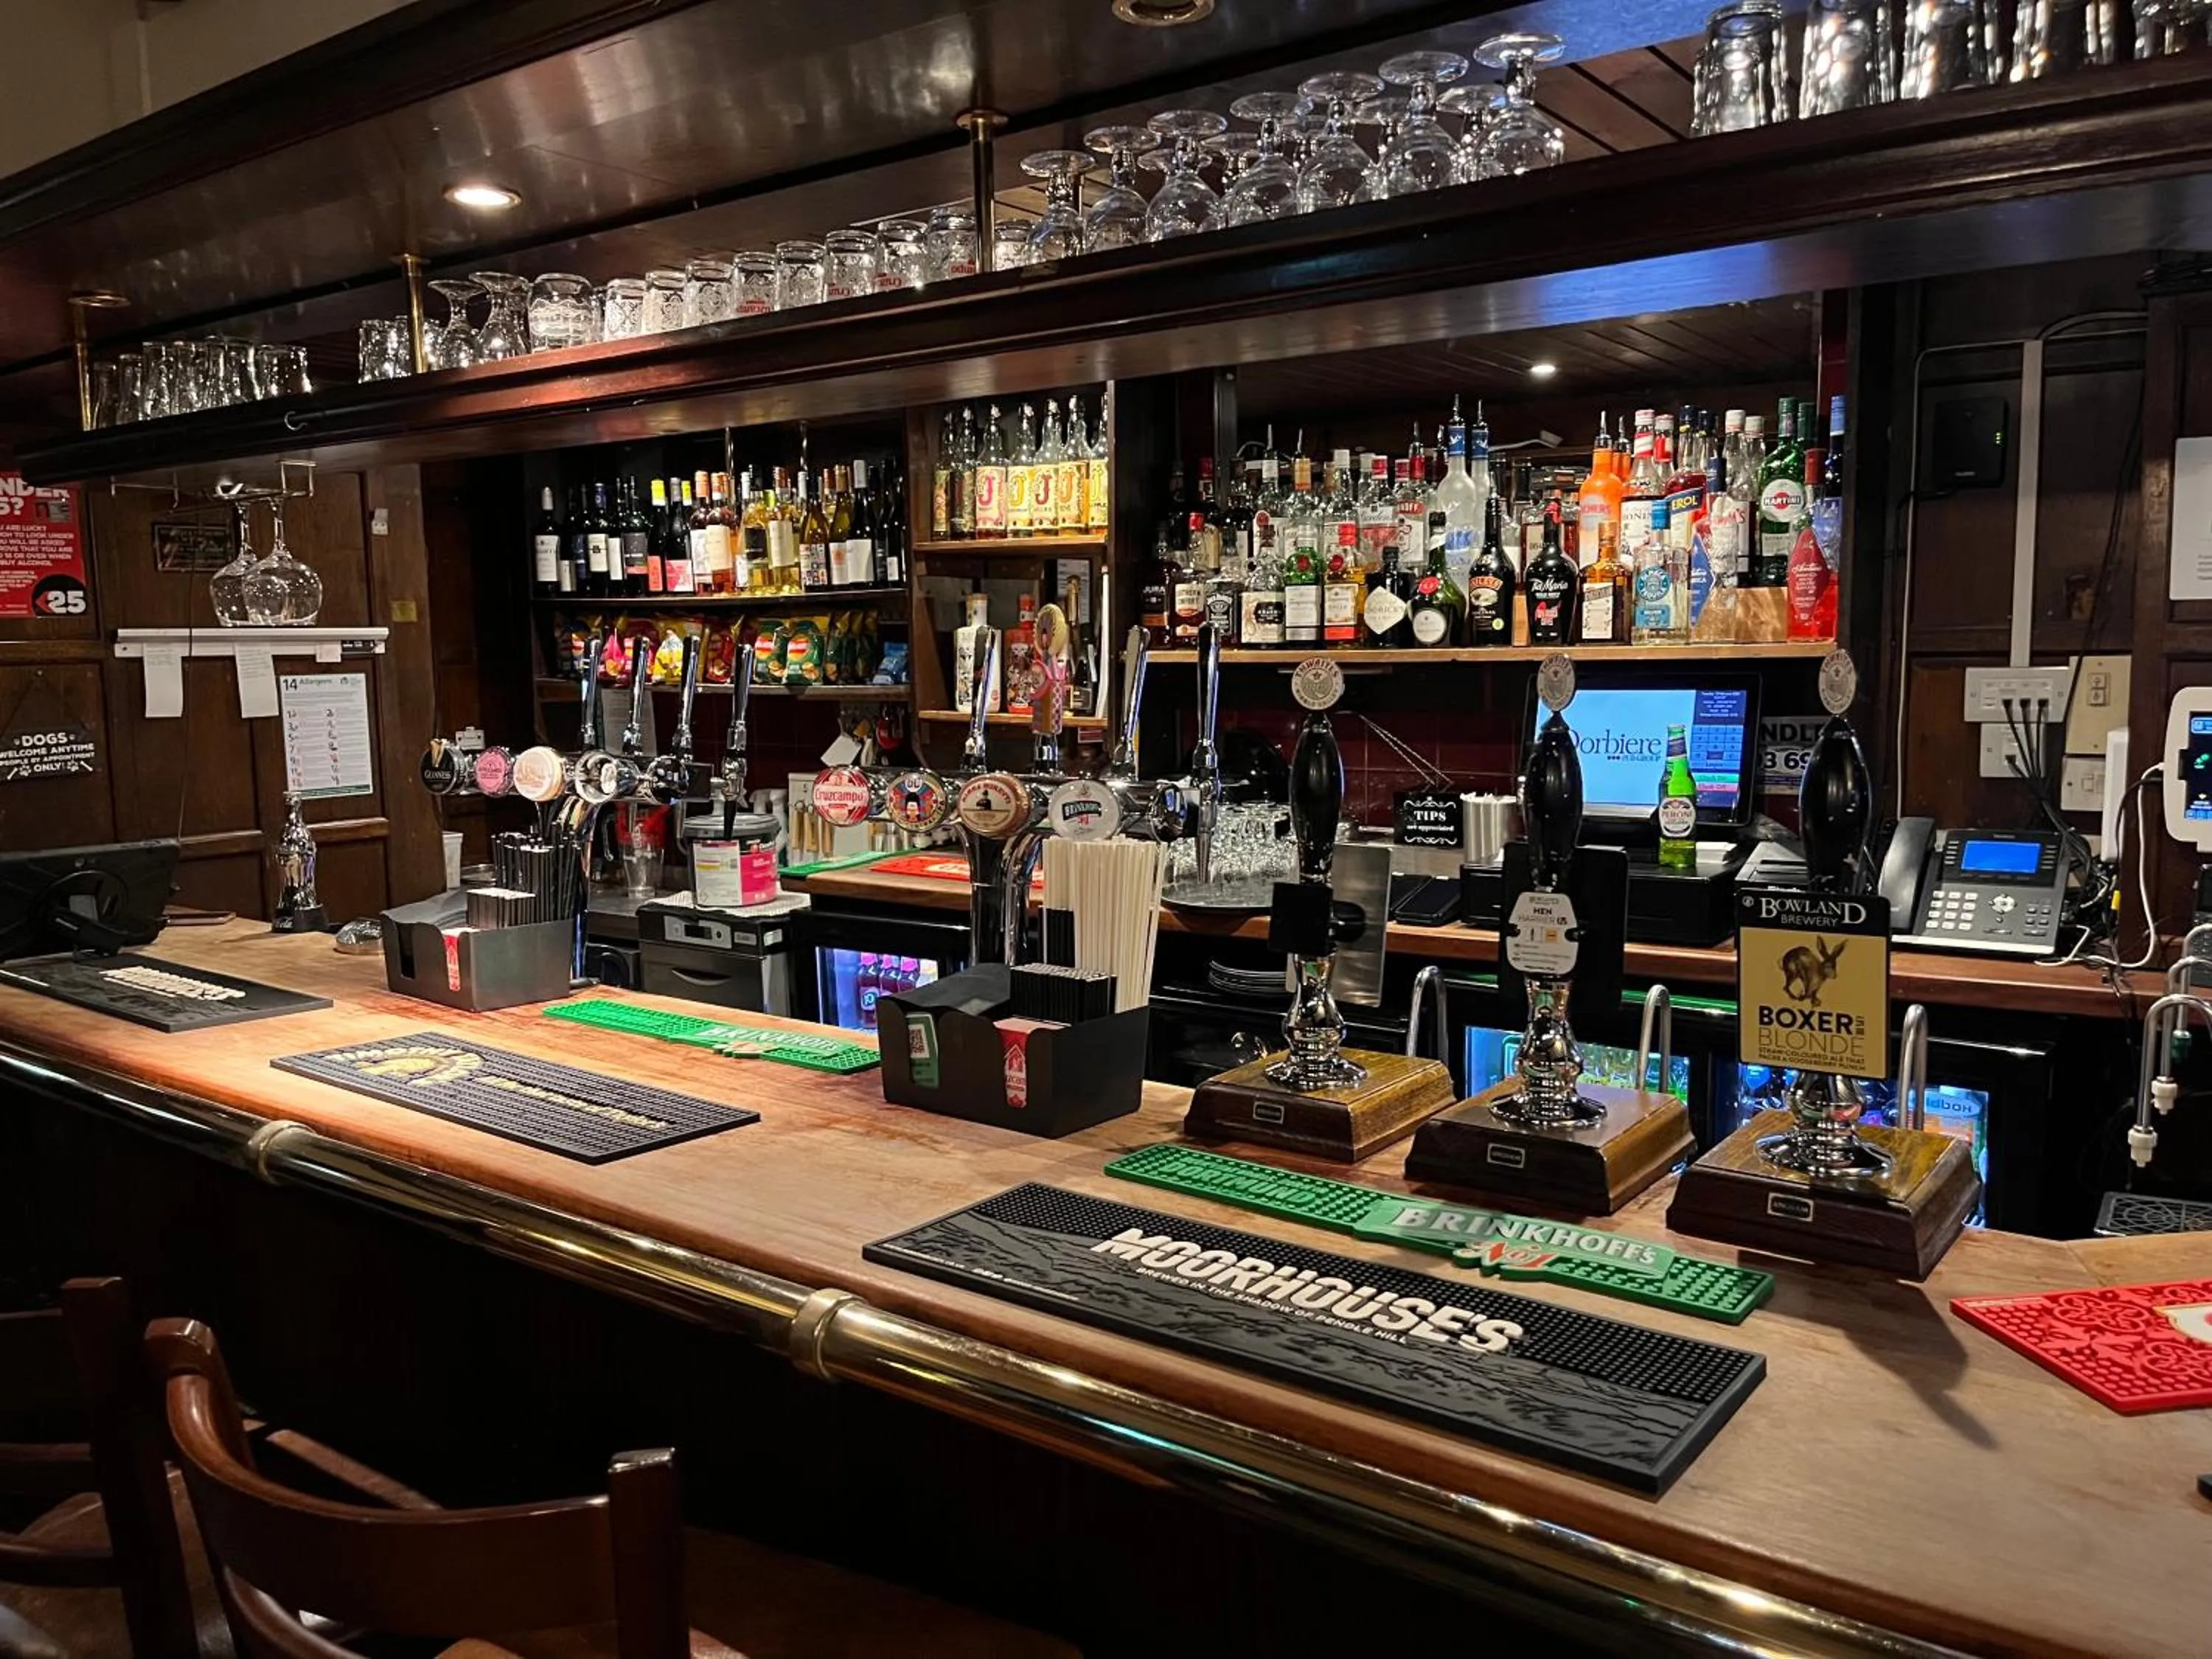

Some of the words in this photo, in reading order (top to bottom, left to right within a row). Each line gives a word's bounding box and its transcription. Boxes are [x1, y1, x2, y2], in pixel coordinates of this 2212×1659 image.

[1035, 474, 1052, 505] J
[1764, 495, 1801, 507] MARTINI
[47, 591, 86, 613] 25
[282, 678, 298, 691] 14
[21, 732, 68, 747] DOGS
[51, 742, 94, 754] ANYTIME
[424, 769, 452, 780] GUINNESS
[815, 787, 864, 804] Cruzcampo
[1414, 810, 1447, 821] TIPS
[1662, 810, 1692, 818] PERONI
[1533, 907, 1552, 915] HEN
[1759, 897, 1867, 925] BOWLAND
[1781, 914, 1839, 927] BREWERY
[1759, 1005, 1854, 1035] BOXER
[1759, 1026, 1865, 1058] BLONDE
[1091, 1228, 1524, 1353] MOORHOUSE'S
[1135, 1267, 1189, 1287] BREWED
[1190, 1281, 1206, 1291] IN
[1208, 1284, 1235, 1298] THE
[1234, 1293, 1295, 1315] SHADOW
[1295, 1308, 1315, 1319] OF
[1315, 1313, 1374, 1335] PENDLE
[1374, 1329, 1407, 1345] HILL
